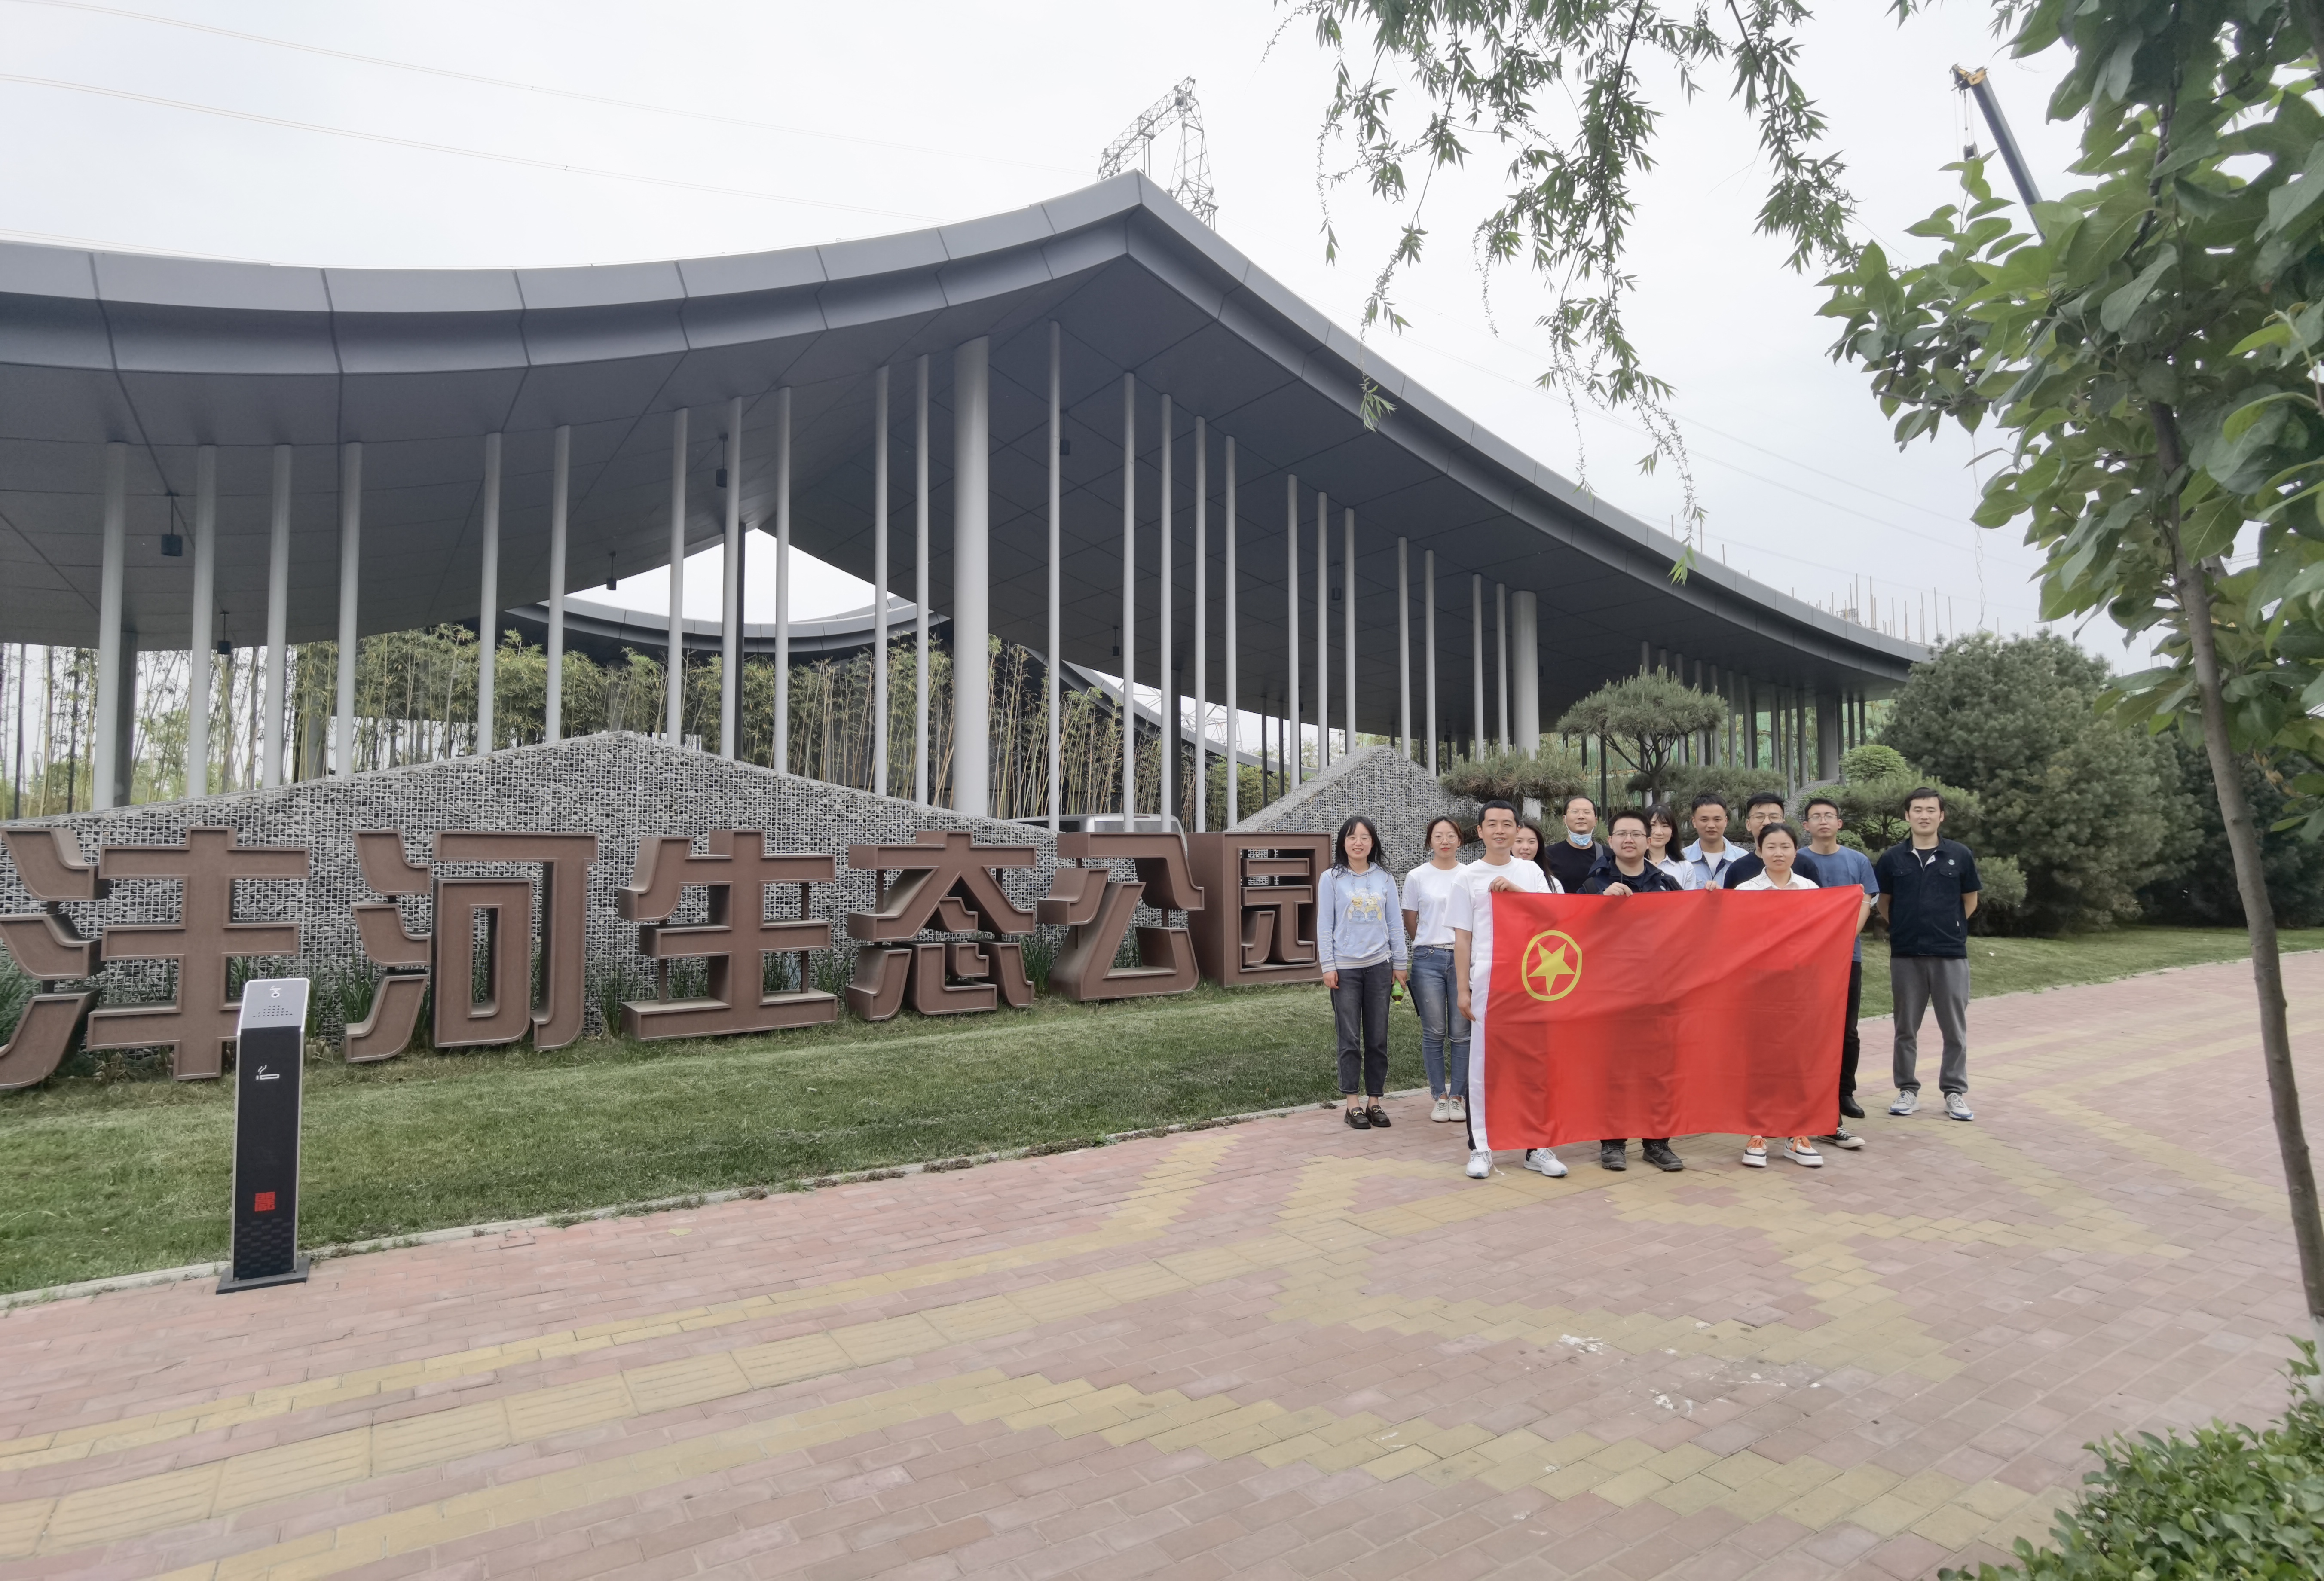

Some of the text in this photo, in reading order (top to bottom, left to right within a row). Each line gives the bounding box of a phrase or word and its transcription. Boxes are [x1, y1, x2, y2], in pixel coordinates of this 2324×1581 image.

[0, 826, 1332, 1088] 沣河生态公园
